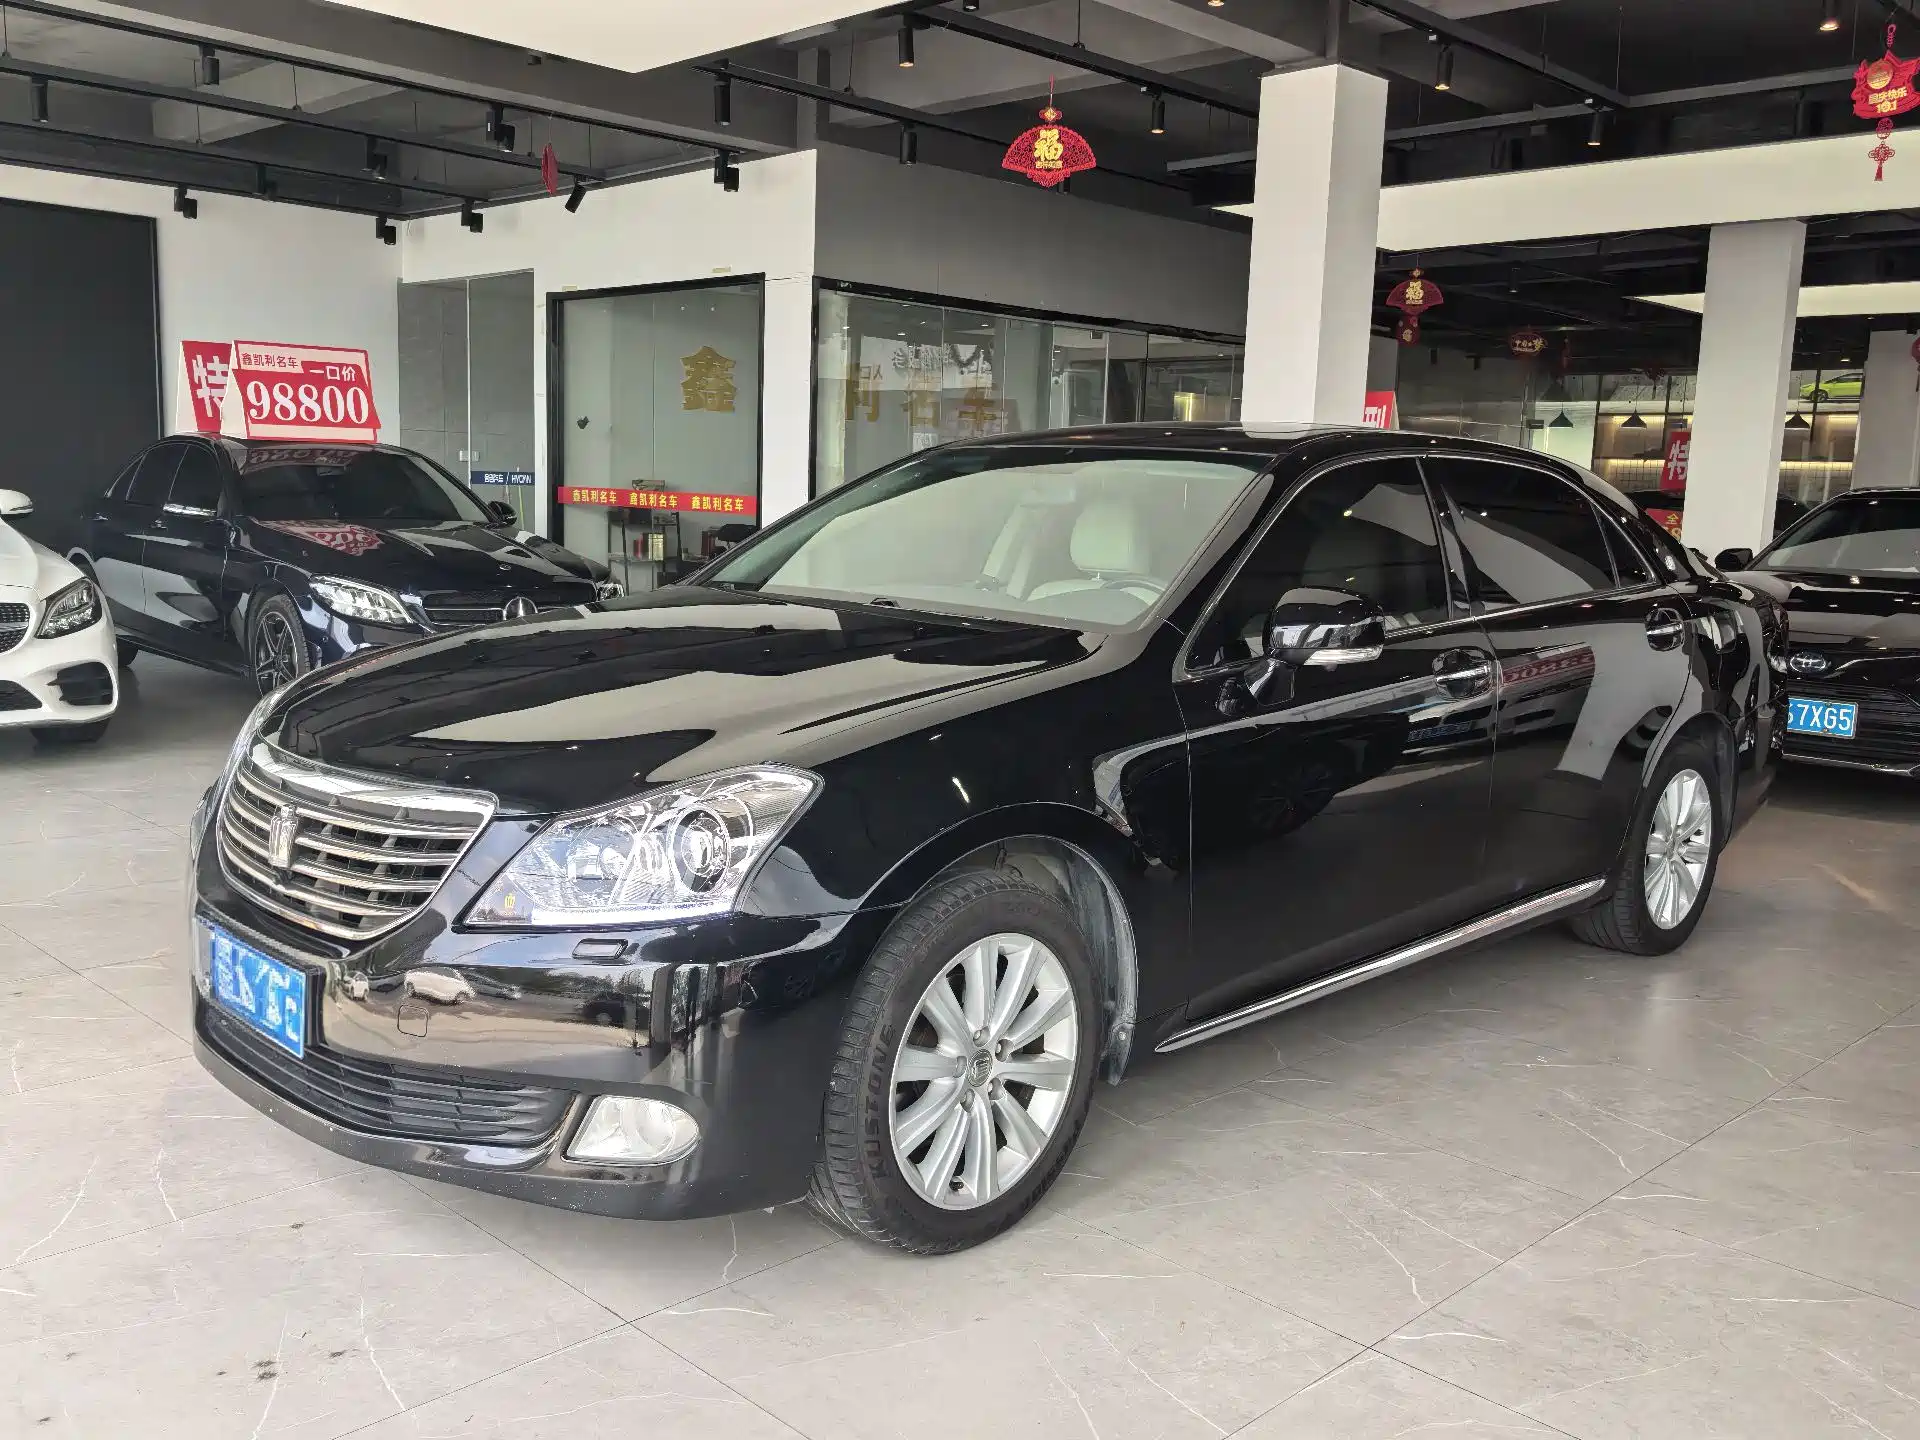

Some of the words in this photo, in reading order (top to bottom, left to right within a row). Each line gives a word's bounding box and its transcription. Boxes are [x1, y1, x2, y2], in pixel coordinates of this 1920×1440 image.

[1034, 129, 1064, 161] 福
[241, 352, 299, 369] 鑫凯利名车
[309, 365, 356, 382] 一口价
[680, 345, 737, 412] 鑫
[246, 380, 369, 424] 98800
[572, 489, 617, 504] 鑫凯利名车
[629, 492, 678, 508] 鑫凯利名车
[691, 495, 744, 512] 鑫凯利名车
